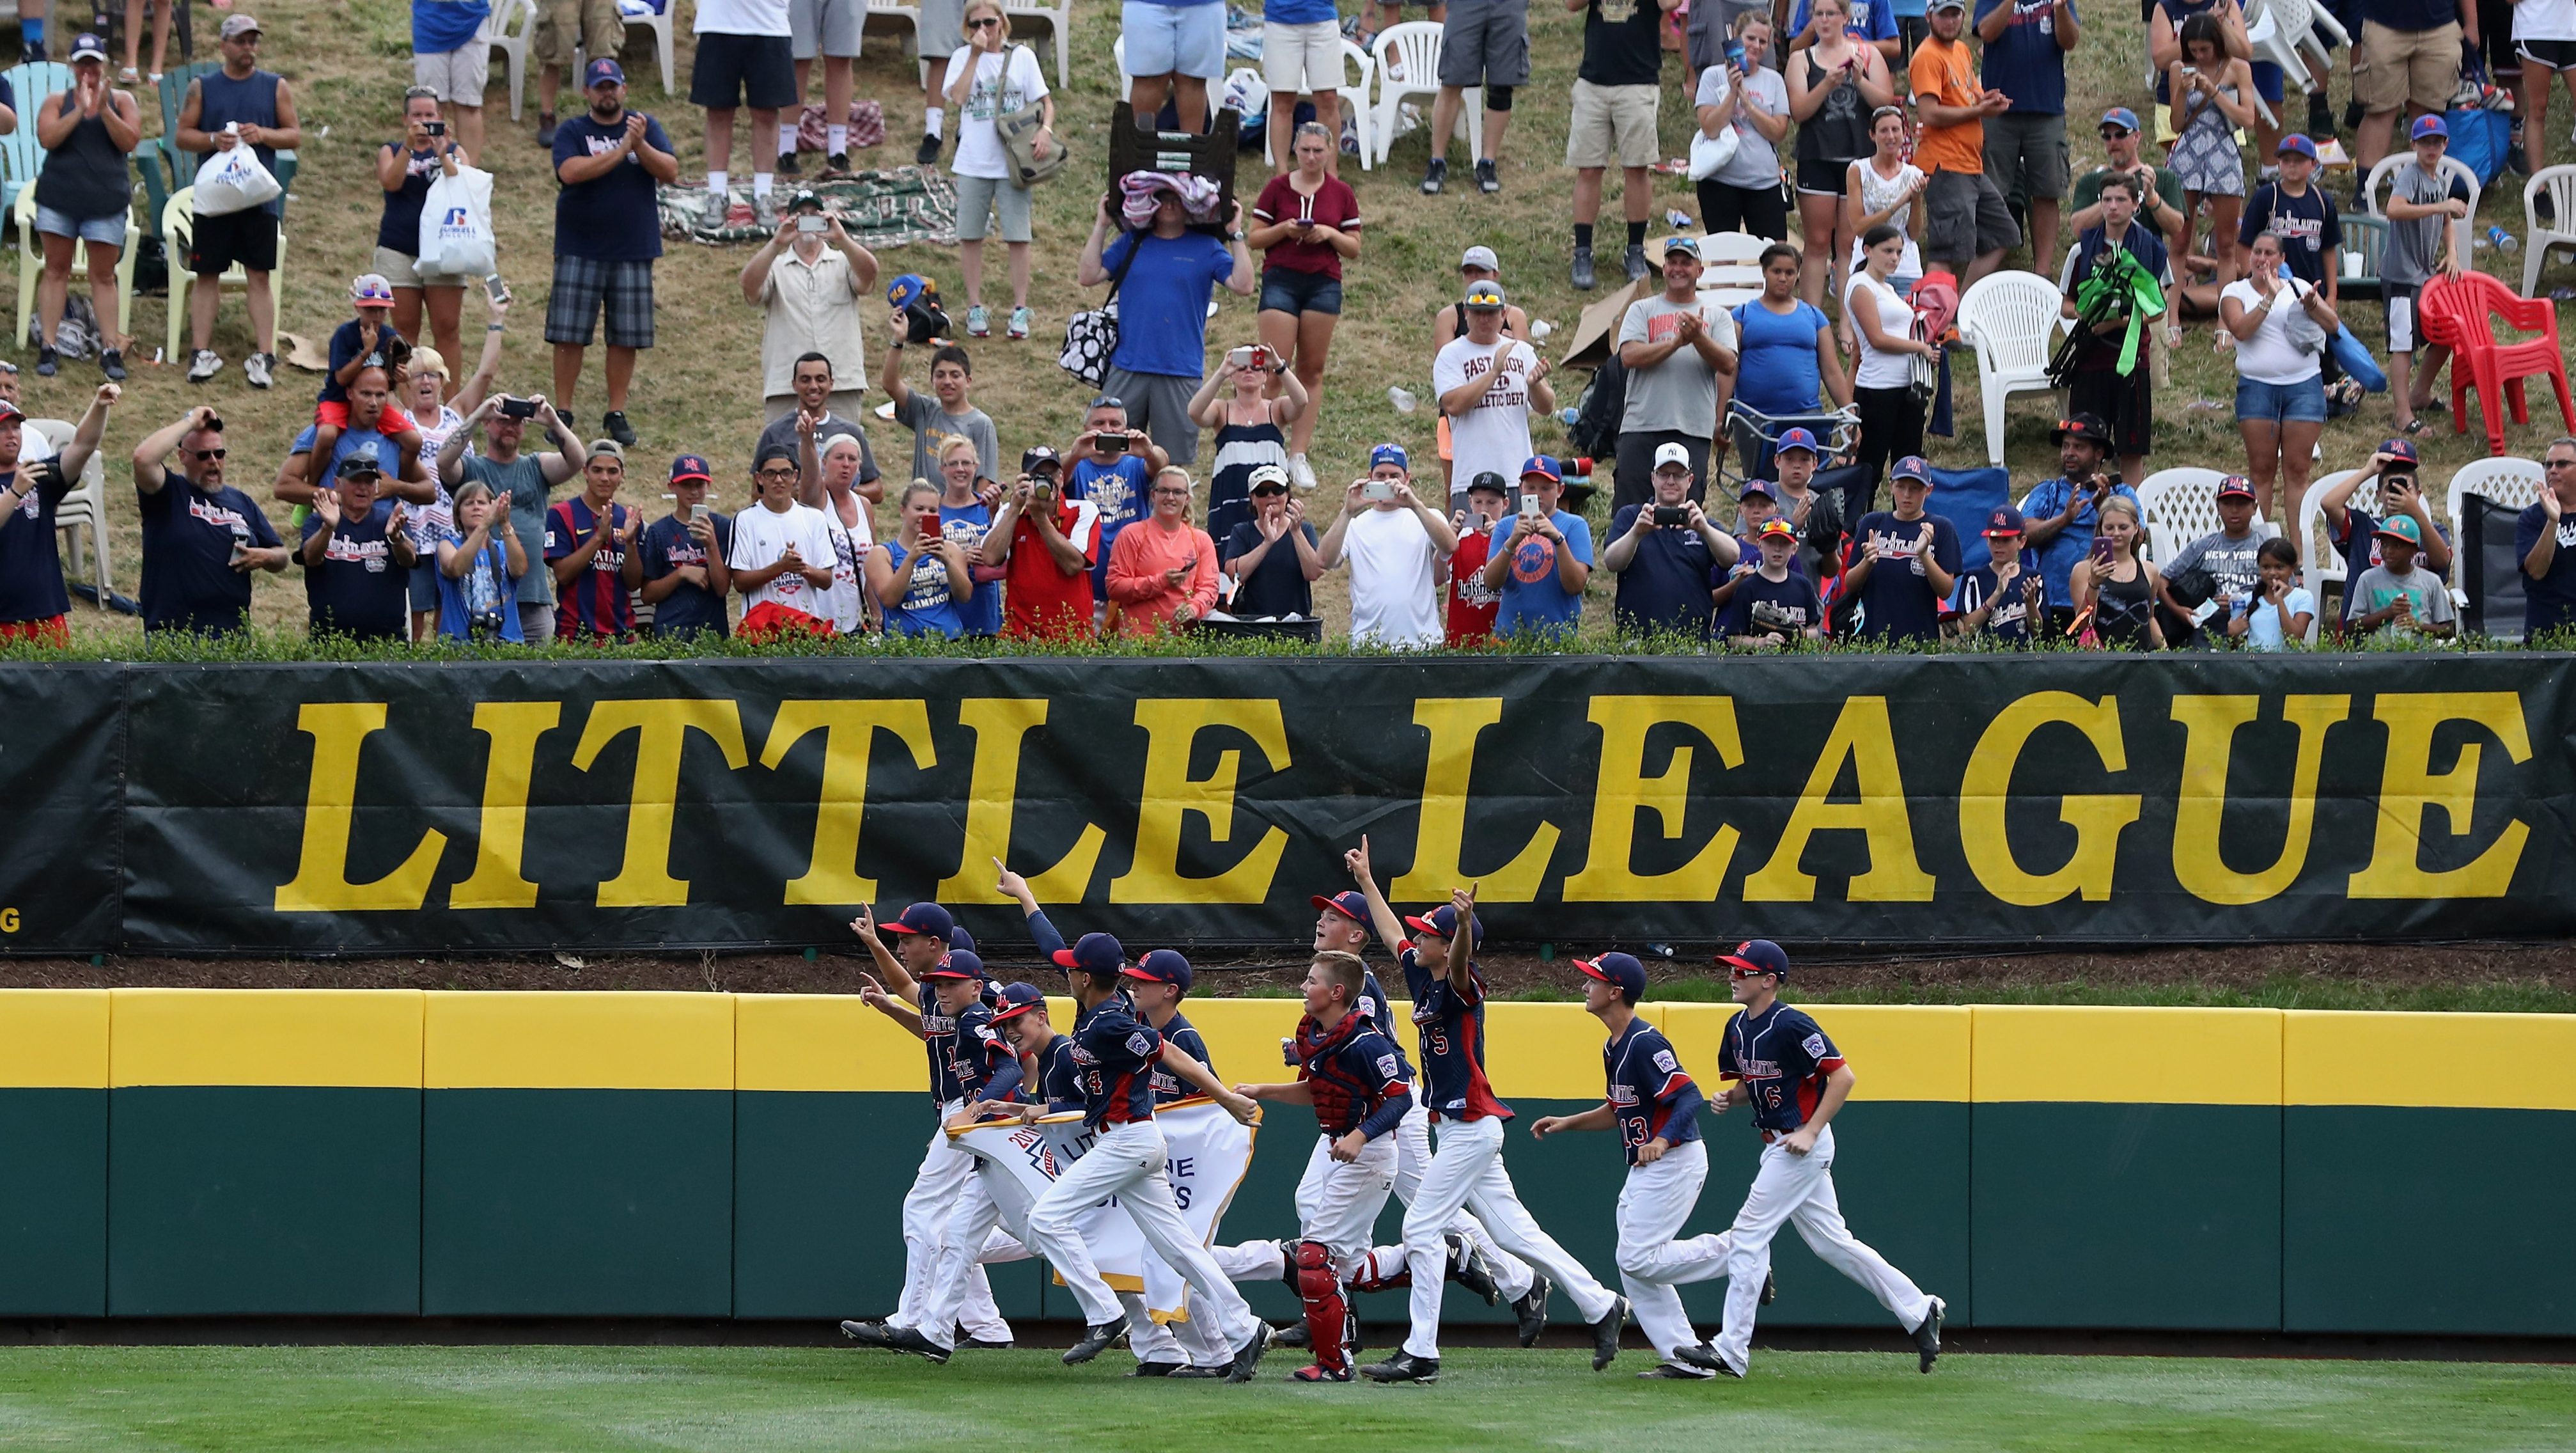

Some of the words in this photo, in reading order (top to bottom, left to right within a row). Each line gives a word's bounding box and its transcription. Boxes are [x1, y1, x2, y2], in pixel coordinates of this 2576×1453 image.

[589, 549, 625, 565] ATAR
[2205, 550, 2229, 561] NEW
[276, 698, 1292, 911] LITTLE
[1390, 690, 2533, 907] LEAGUE
[1430, 1026, 1449, 1056] 5
[1087, 1069, 1103, 1095] 4
[1765, 1085, 1784, 1110] 6
[1620, 1115, 1649, 1149] 13
